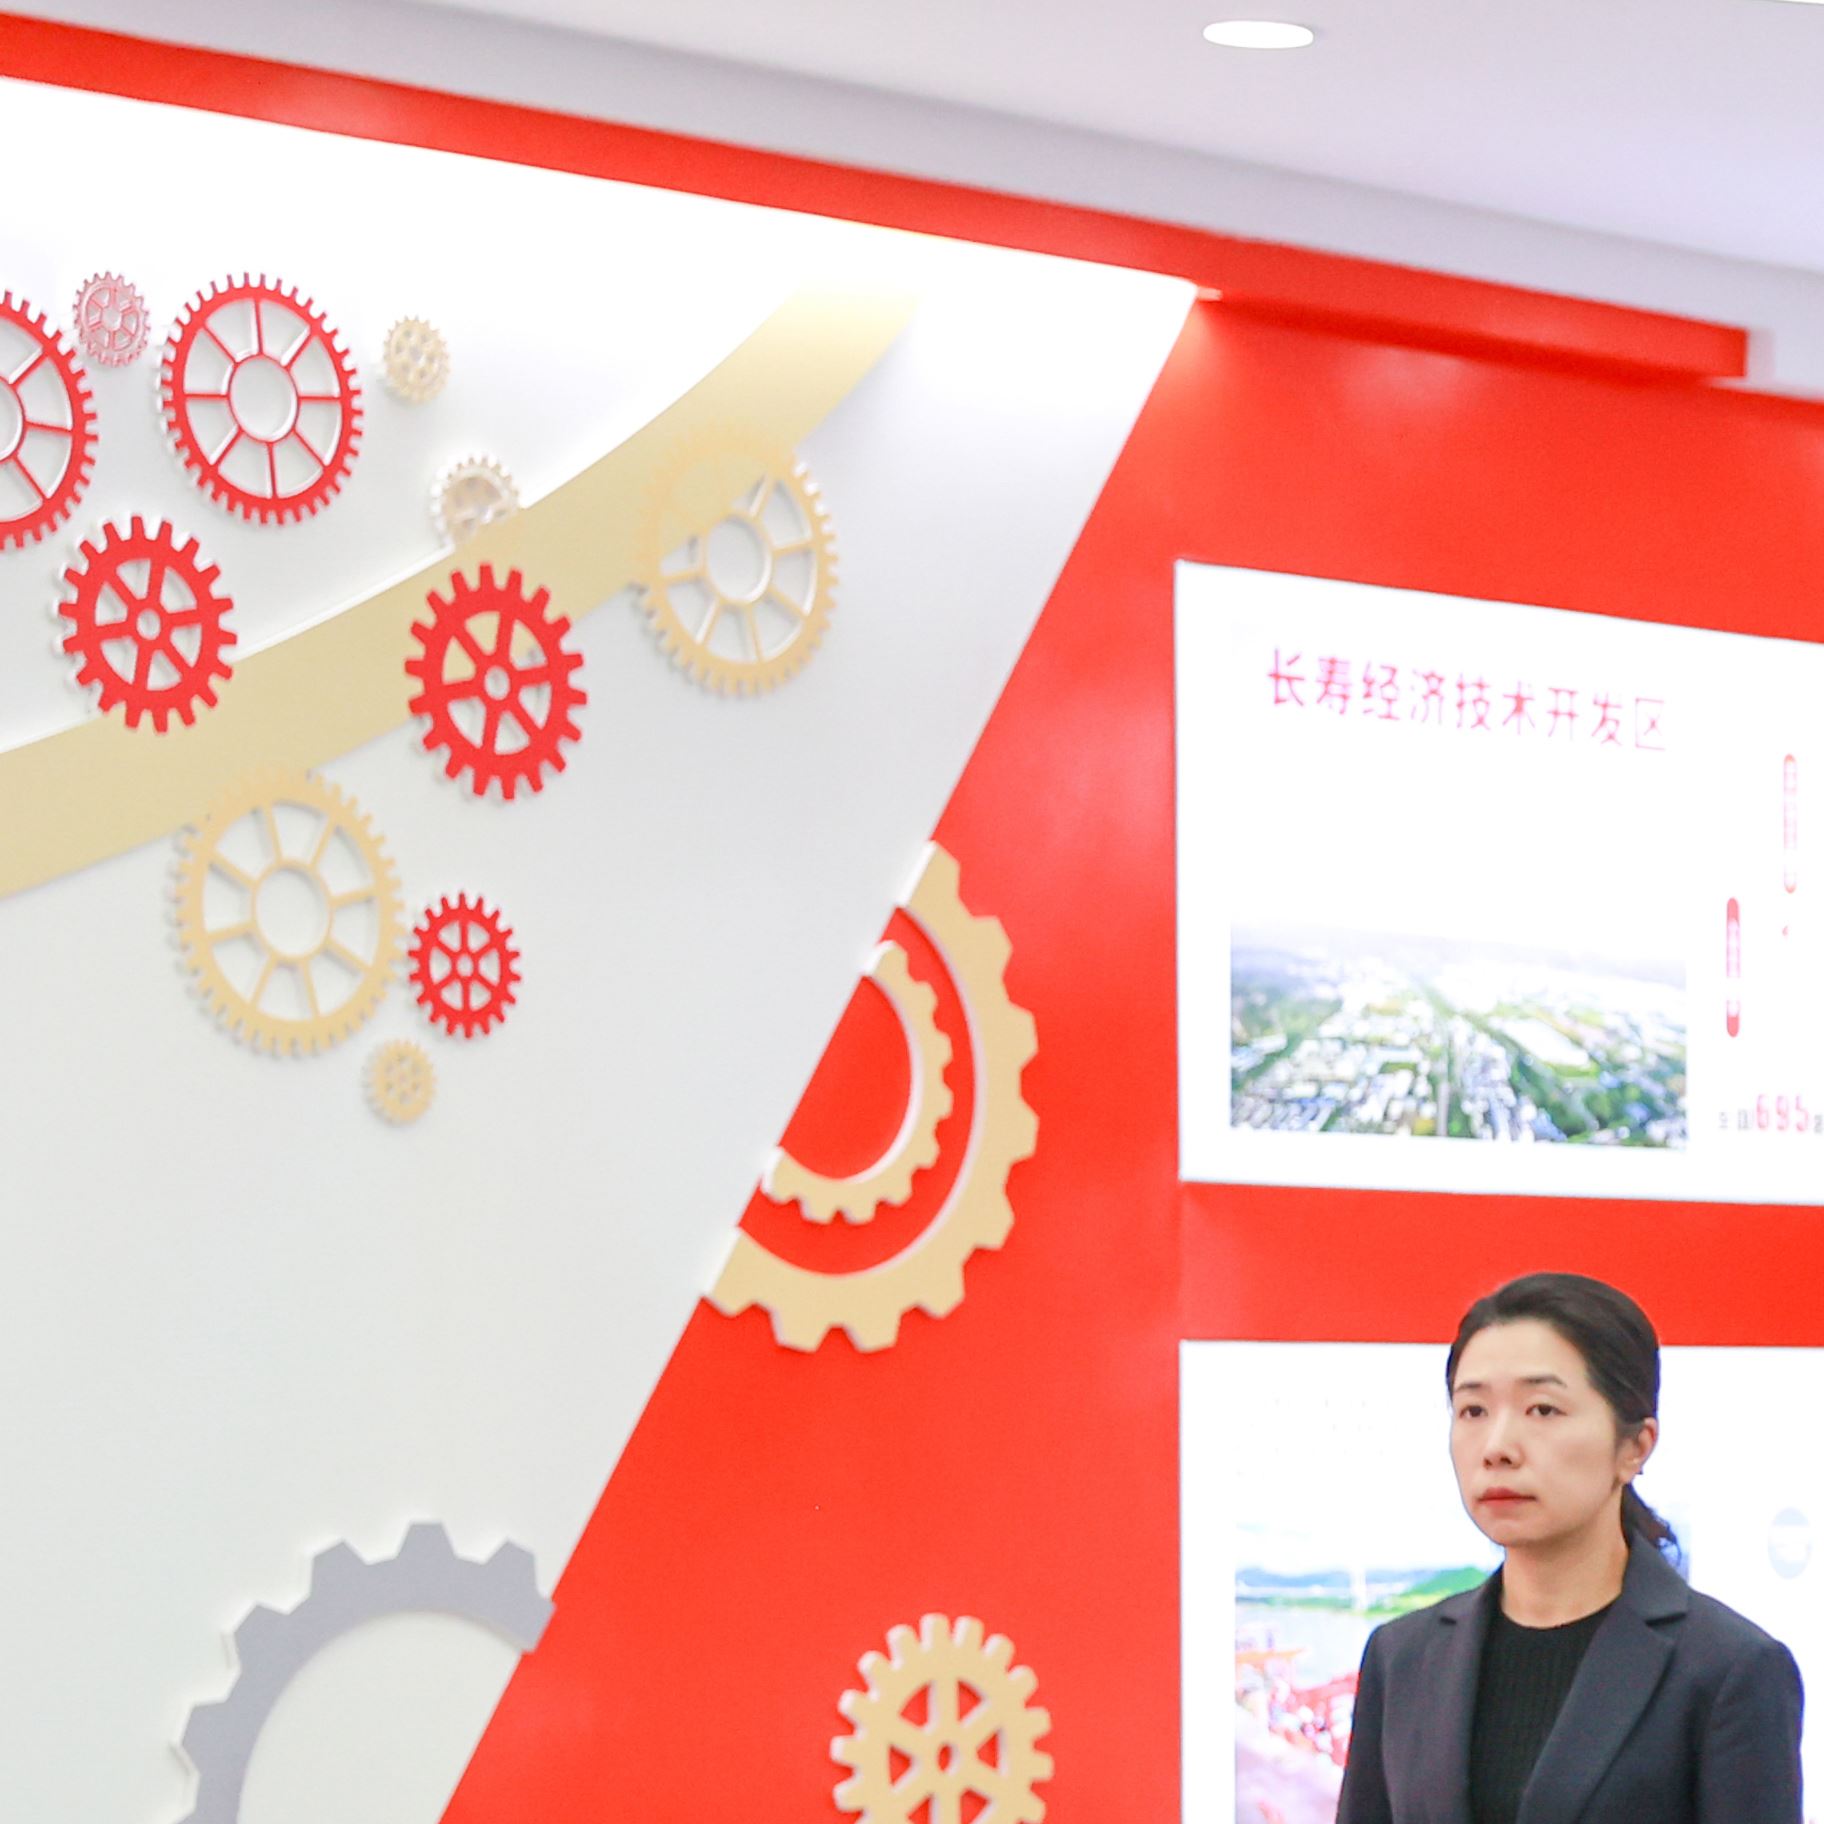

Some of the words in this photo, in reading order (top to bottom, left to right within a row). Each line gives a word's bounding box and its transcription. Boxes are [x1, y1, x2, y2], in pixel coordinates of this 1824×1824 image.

[1267, 645, 1666, 752] 长寿经济技术开发区
